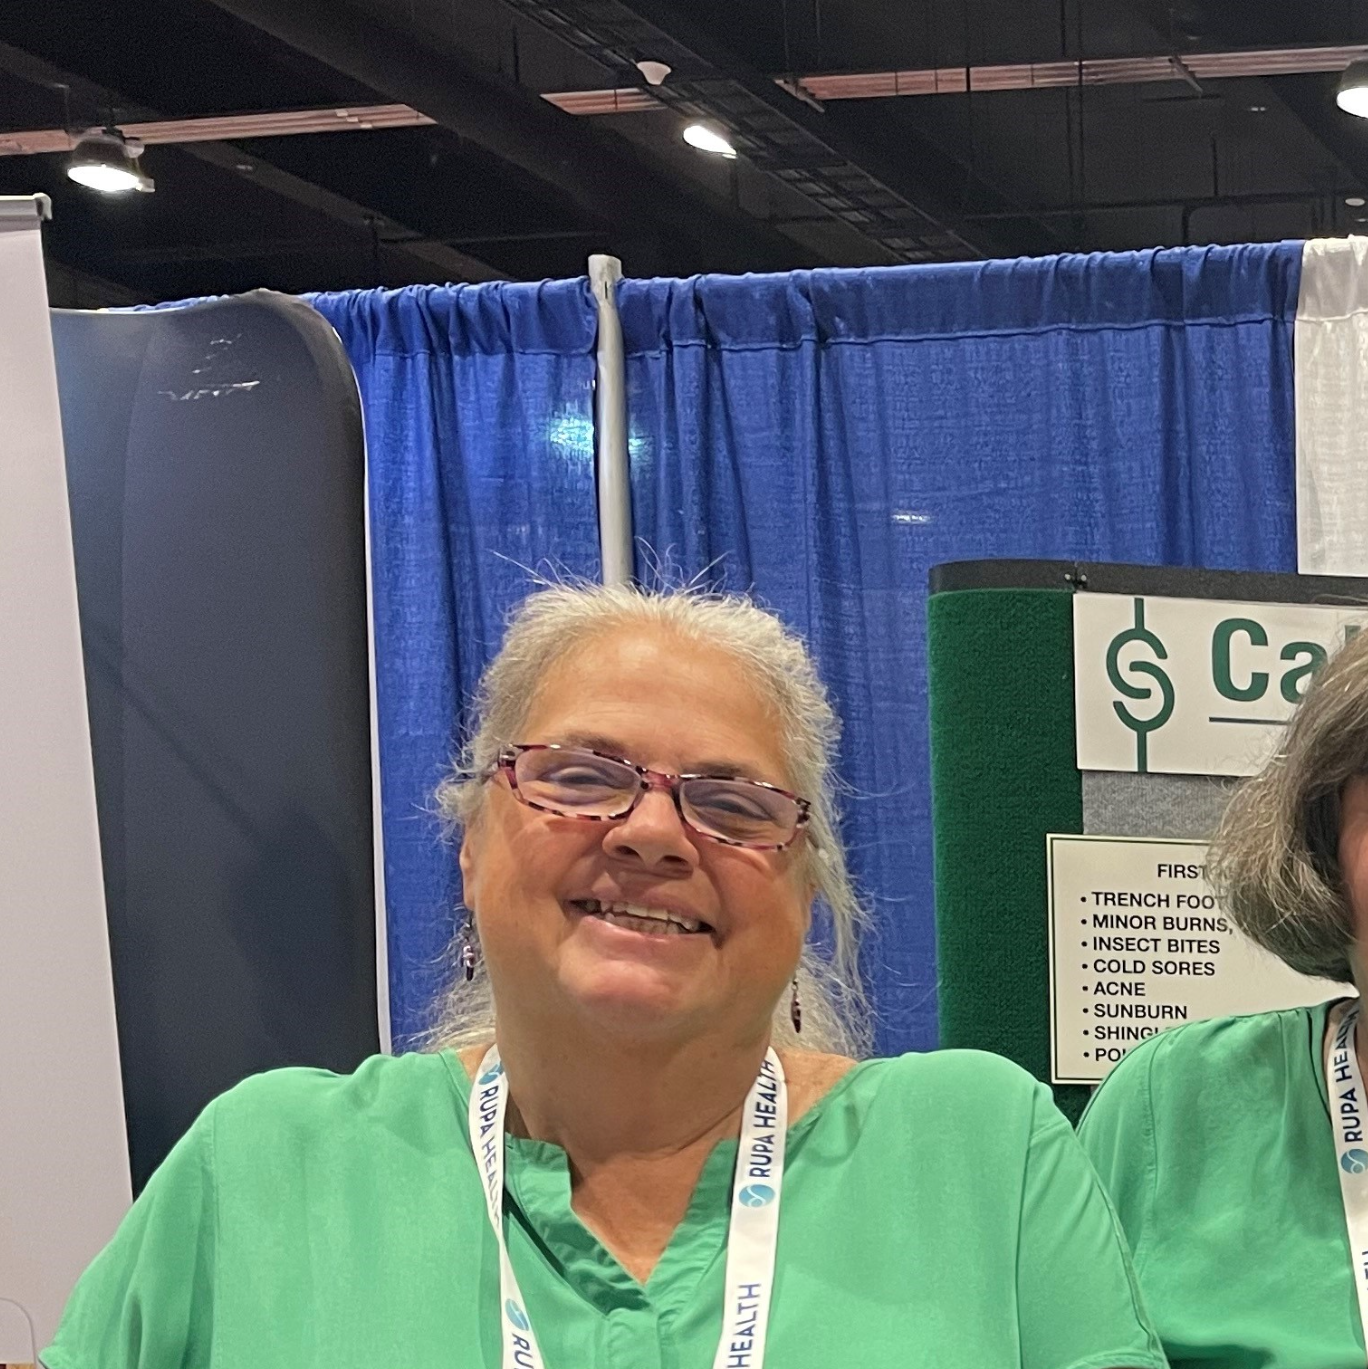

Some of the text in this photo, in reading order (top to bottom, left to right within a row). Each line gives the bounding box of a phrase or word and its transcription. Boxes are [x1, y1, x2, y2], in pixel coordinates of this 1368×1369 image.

[1091, 891, 1170, 908] TRENCH
[1092, 914, 1233, 935] MINOR BURNS,
[1093, 936, 1220, 954] INSECT BITES
[1093, 958, 1216, 976] COLD SORES
[1093, 981, 1146, 996] ACNE
[1094, 1003, 1188, 1020] SUNBURN
[480, 1085, 500, 1139] RUPA
[749, 1058, 778, 1178] RUPA HEALTH
[1339, 1087, 1363, 1143] RUPA
[727, 1283, 762, 1368] HEALTH
